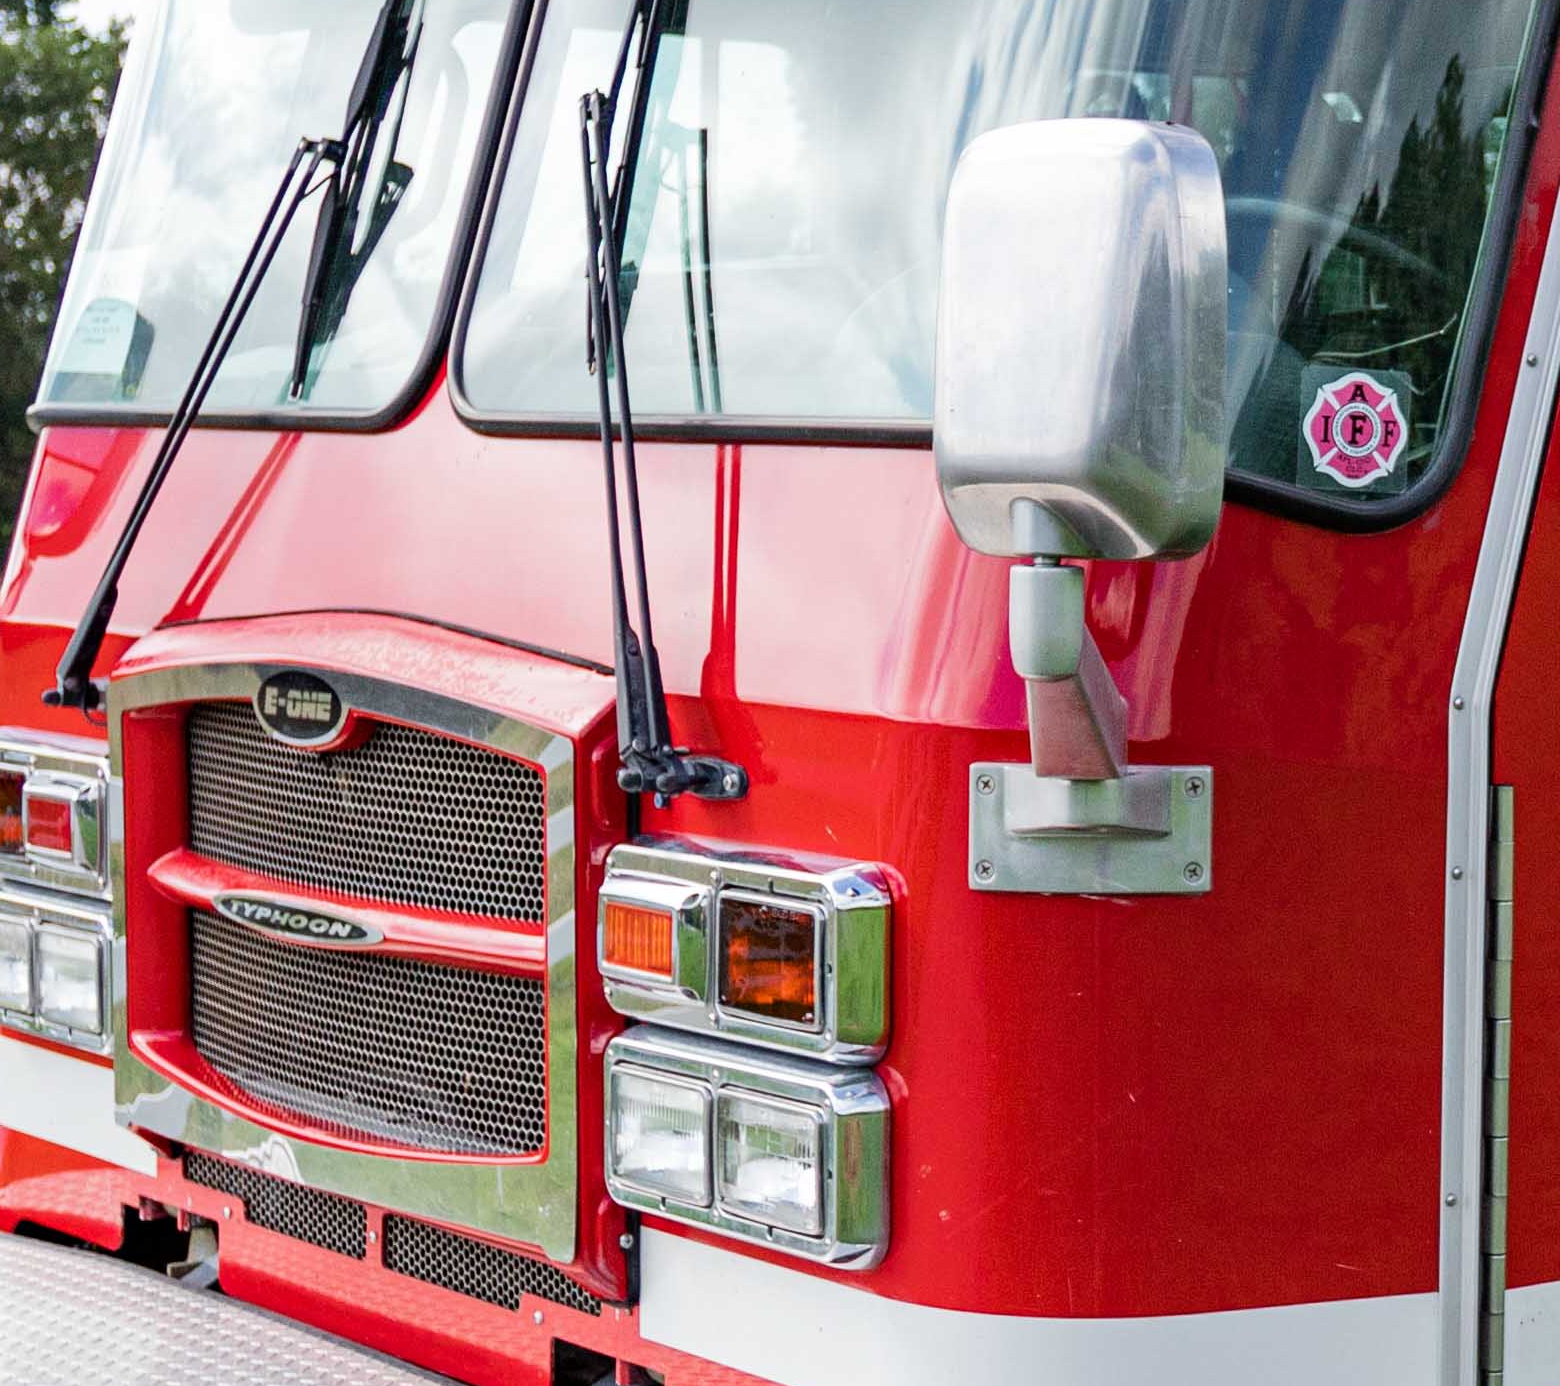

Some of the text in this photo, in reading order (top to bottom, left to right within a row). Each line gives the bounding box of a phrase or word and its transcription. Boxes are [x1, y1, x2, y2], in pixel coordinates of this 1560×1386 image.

[1348, 384, 1369, 403] A
[1348, 414, 1367, 445] F
[1382, 420, 1397, 447] F
[264, 686, 332, 722] E-ONE
[230, 900, 352, 937] TYPHOON
